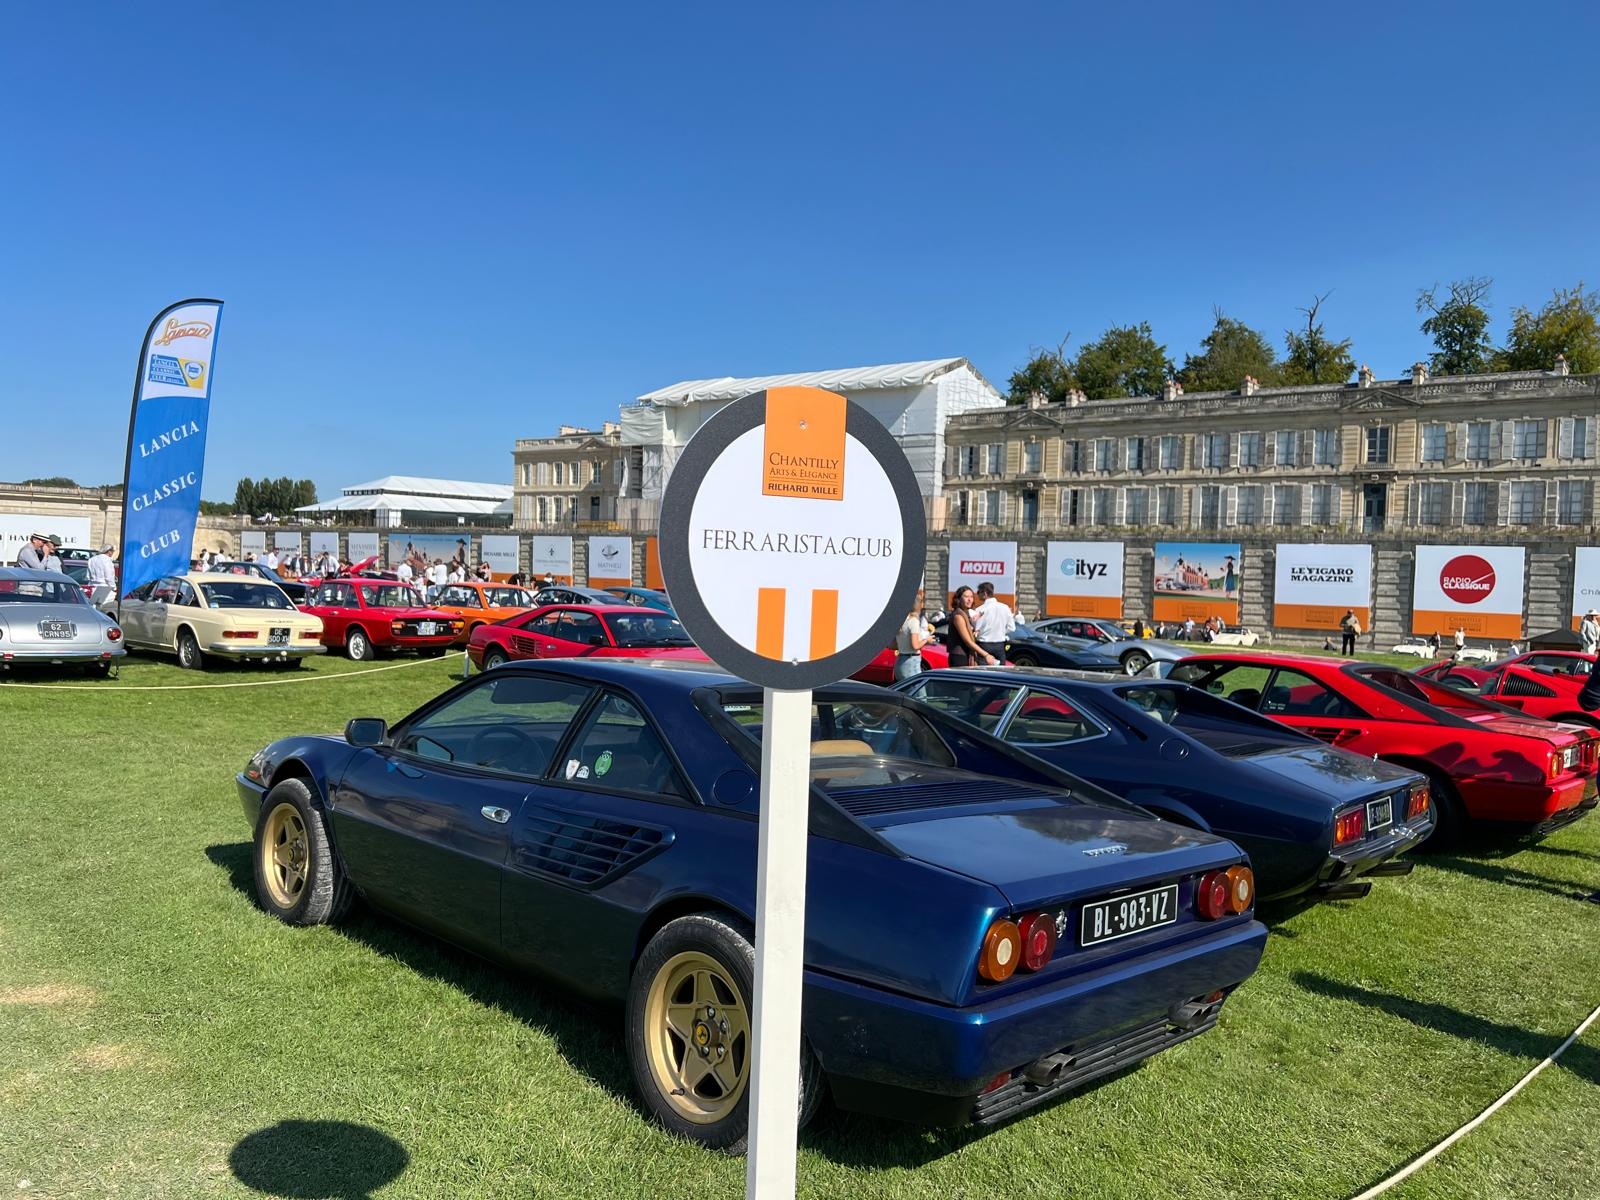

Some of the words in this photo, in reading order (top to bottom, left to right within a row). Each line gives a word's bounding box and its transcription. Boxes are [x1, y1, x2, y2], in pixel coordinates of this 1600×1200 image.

[154, 317, 212, 345] Lancia
[139, 420, 200, 458] LANCIA
[769, 452, 839, 470] CHANTILLY
[769, 467, 790, 476] ARTS
[791, 469, 797, 477] &
[132, 471, 197, 512] CLASSIC
[768, 483, 809, 493] RICHARD
[811, 486, 838, 495] MILLE
[140, 529, 180, 559] CLUB
[703, 529, 892, 557] FERRARISTA.CLUB
[962, 563, 1003, 573] MOTUL
[1061, 558, 1108, 580] Cityz
[1306, 565, 1354, 576] FIGARO
[1290, 575, 1354, 583] MAGAZINE
[1443, 576, 1471, 584] RADIO
